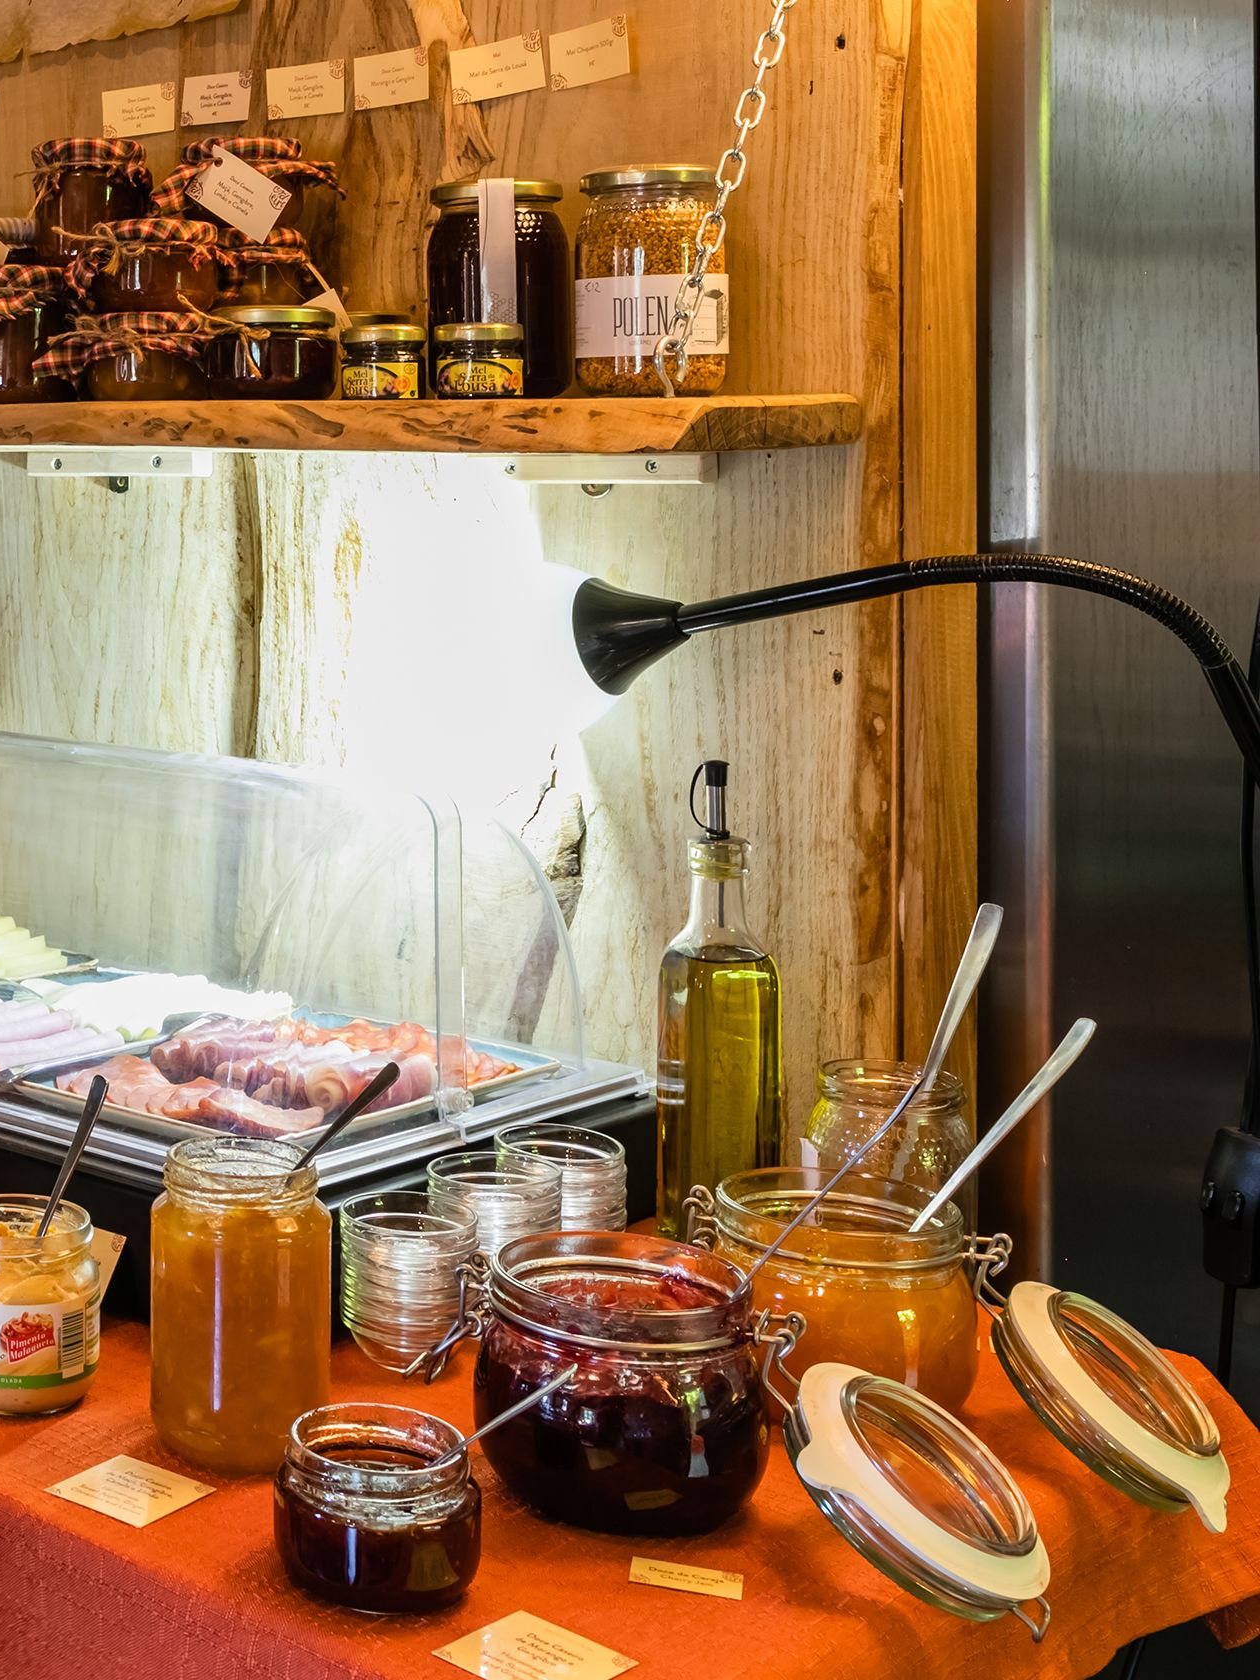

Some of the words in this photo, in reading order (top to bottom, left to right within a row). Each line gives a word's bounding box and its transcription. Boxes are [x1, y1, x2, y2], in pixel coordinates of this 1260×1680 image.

[469, 70, 480, 78] Mel
[489, 66, 503, 74] Serra
[232, 202, 248, 216] Canela
[612, 296, 669, 337] POLEN
[353, 370, 368, 378] Mel
[470, 365, 486, 374] Mel
[347, 377, 368, 385] Serra
[460, 372, 487, 382] Serra
[346, 384, 369, 395] Lous
[454, 378, 496, 392] Lousã
[10, 1332, 46, 1349] Pimento
[10, 1339, 54, 1360] Malagueta
[649, 1566, 674, 1575] Doce
[692, 1574, 724, 1584] Cereja
[660, 1574, 692, 1584] Cherry
[515, 1636, 526, 1644] de
[527, 1642, 567, 1664] Morango
[527, 1633, 550, 1645] Doce
[552, 1642, 584, 1662] Caseiro
[517, 1645, 557, 1667] Gengibre
